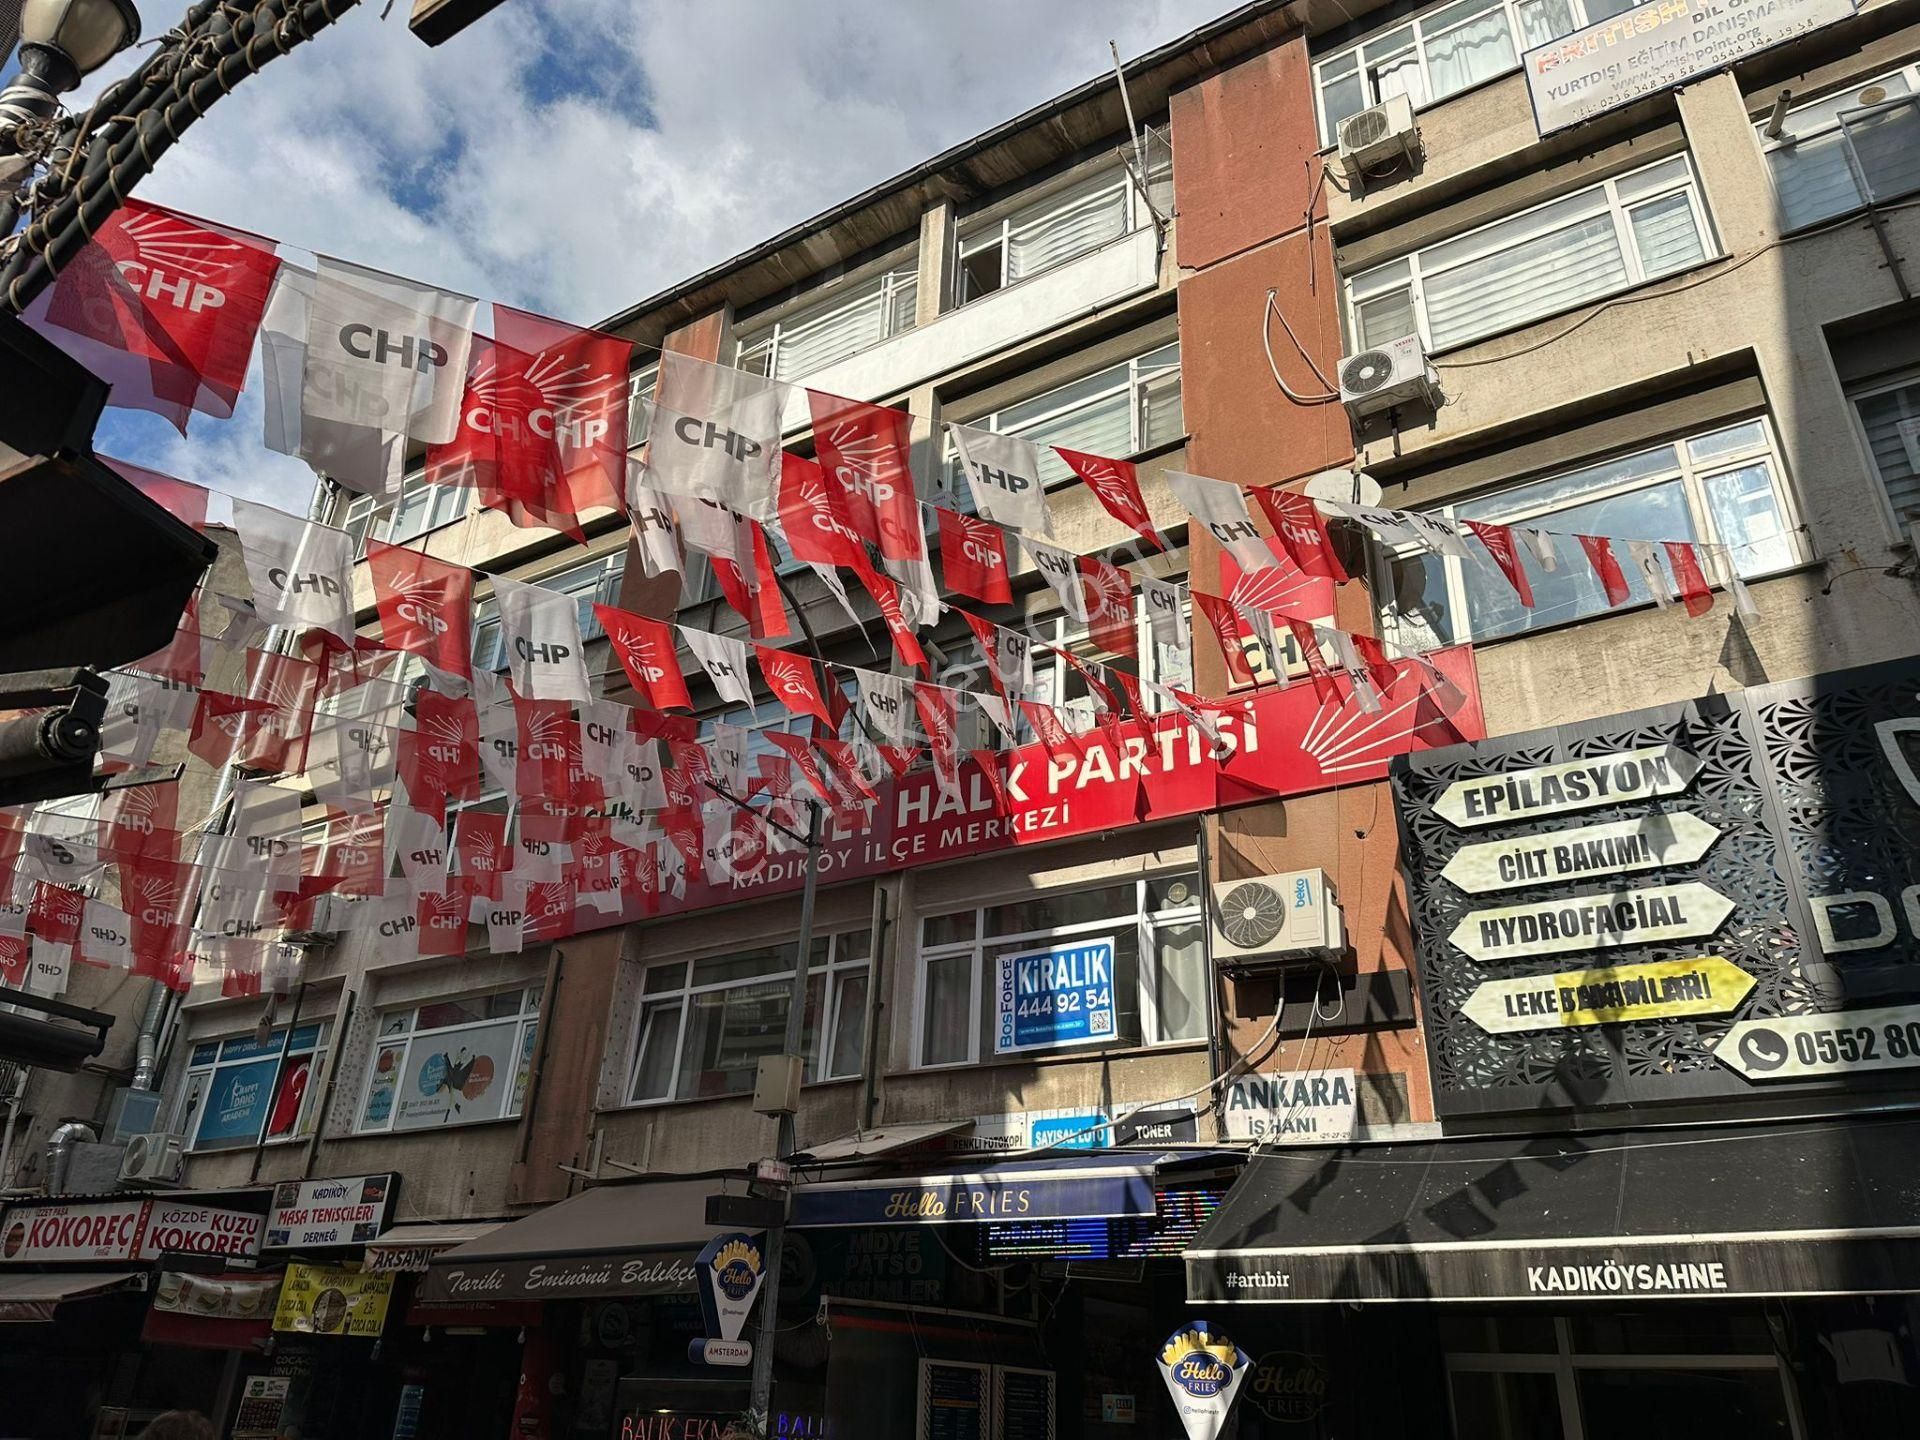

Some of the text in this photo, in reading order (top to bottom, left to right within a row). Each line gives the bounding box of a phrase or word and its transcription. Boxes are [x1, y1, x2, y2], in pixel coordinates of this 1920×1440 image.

[1546, 62, 1623, 101] YURTDIŞI
[114, 260, 226, 313] CHP
[338, 321, 449, 375] CHP
[527, 407, 609, 449] CHP
[674, 416, 764, 462] CHP
[834, 465, 894, 508] CHP
[962, 540, 1001, 570] CHP
[267, 567, 340, 598] CHP
[396, 604, 448, 635] CHP
[514, 636, 570, 664] CHP
[897, 759, 1030, 829] HALK
[1047, 700, 1259, 795] PARTİSİ
[1462, 755, 1671, 820] EPİLASYON
[863, 831, 926, 863] İLÇE
[938, 797, 1070, 849] MERKEZİ
[1497, 846, 1549, 884] CİLT
[1294, 877, 1305, 909] beko
[380, 916, 416, 937] CHP
[430, 915, 462, 930] CHP
[490, 911, 522, 927] CHP
[1479, 894, 1688, 950] HYDROFACİAL
[1000, 958, 1013, 1049] BOSFORCE
[1017, 987, 1111, 1019] 444 92 54
[1503, 988, 1559, 1019] LEKE
[1793, 1026, 1881, 1067] 0552
[1229, 1076, 1352, 1112] ANKARA
[1135, 1123, 1173, 1140] TONER
[278, 1209, 309, 1226] MASA
[884, 1189, 1031, 1219] Hello FRIES
[26, 1213, 136, 1254] KOKOREÇ
[161, 1208, 260, 1236] KÖZDE KUZU
[447, 1269, 505, 1295] Tarihi
[524, 1263, 611, 1291] Eminönü
[723, 1267, 753, 1286] Hello
[1527, 1259, 1728, 1292] KADIKÖYSAHNE
[708, 1347, 750, 1359] AMSTERDAM
[1179, 1360, 1225, 1381] Hello
[1253, 1364, 1326, 1395] Hello
[1187, 1382, 1218, 1394] FRIES
